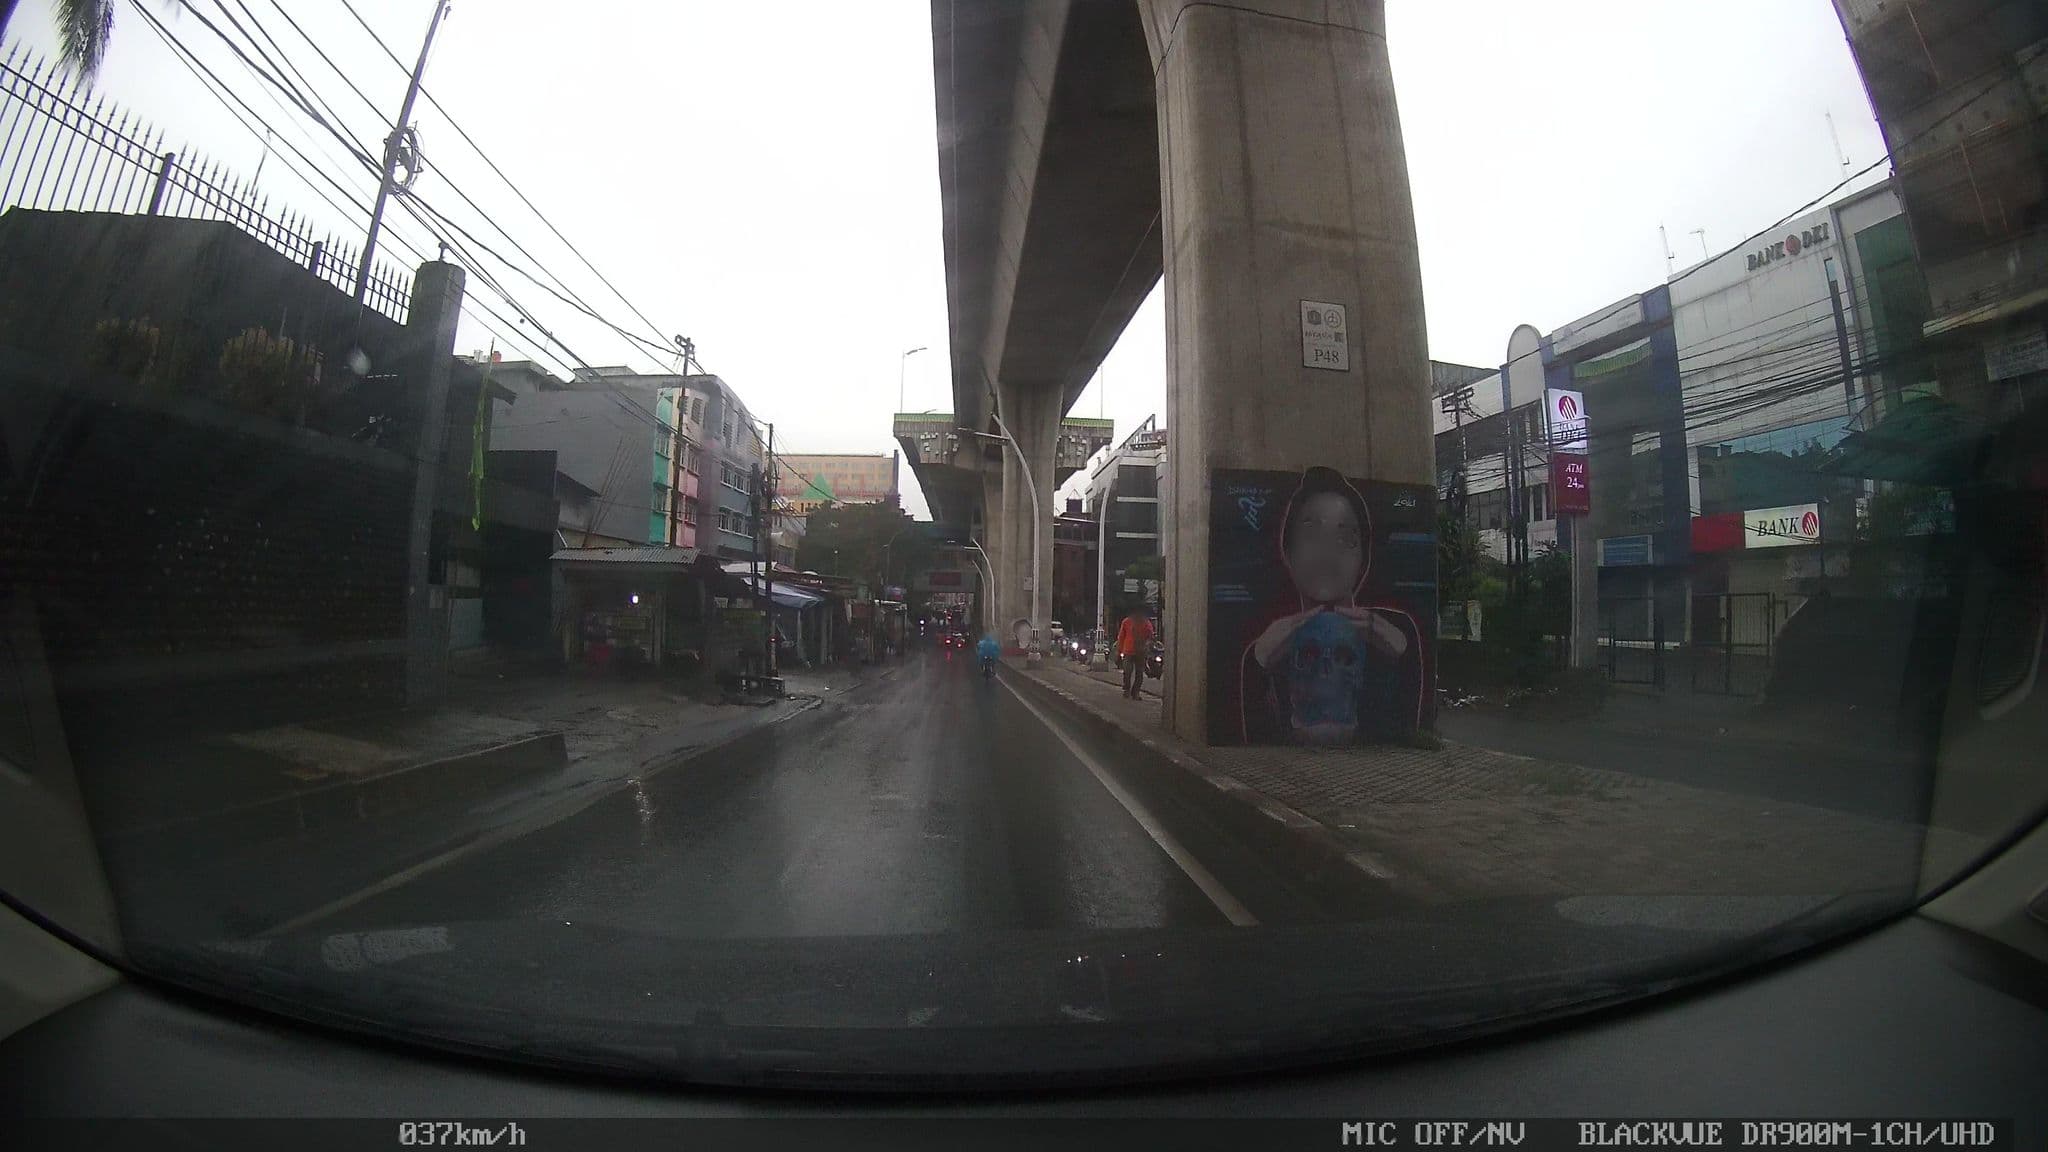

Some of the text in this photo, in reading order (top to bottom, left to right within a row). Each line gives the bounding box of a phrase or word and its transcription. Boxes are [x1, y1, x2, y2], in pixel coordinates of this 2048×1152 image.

[1747, 222, 1829, 271] BANK DKI
[1314, 349, 1339, 363] P48
[1565, 463, 1583, 473] ATM
[1757, 517, 1799, 536] BANK
